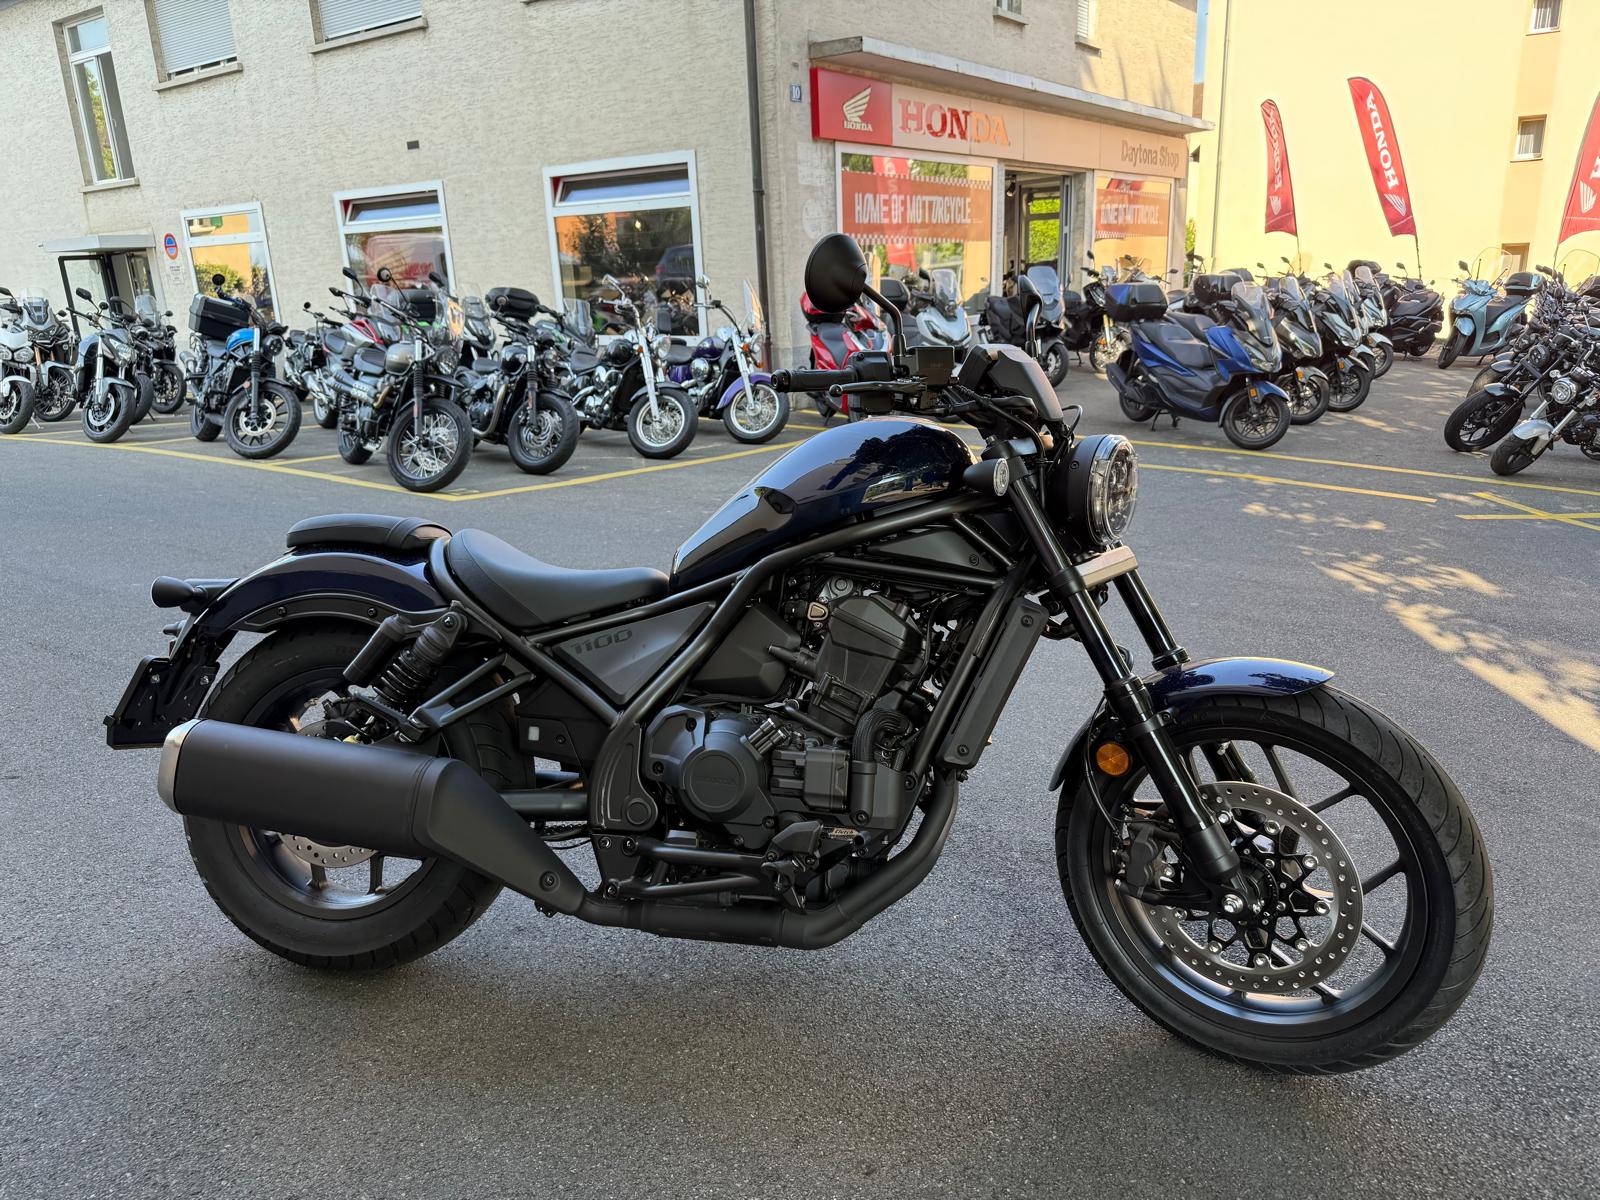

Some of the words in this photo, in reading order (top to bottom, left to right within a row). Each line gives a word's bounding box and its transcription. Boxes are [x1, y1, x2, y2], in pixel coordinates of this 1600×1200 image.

[792, 85, 800, 97] 10
[844, 120, 873, 132] HONDA
[898, 98, 1010, 146] HONDA
[1366, 90, 1399, 190] HONDA
[1121, 139, 1158, 167] Daytona
[1160, 145, 1180, 171] Shop
[571, 629, 633, 654] 1100
